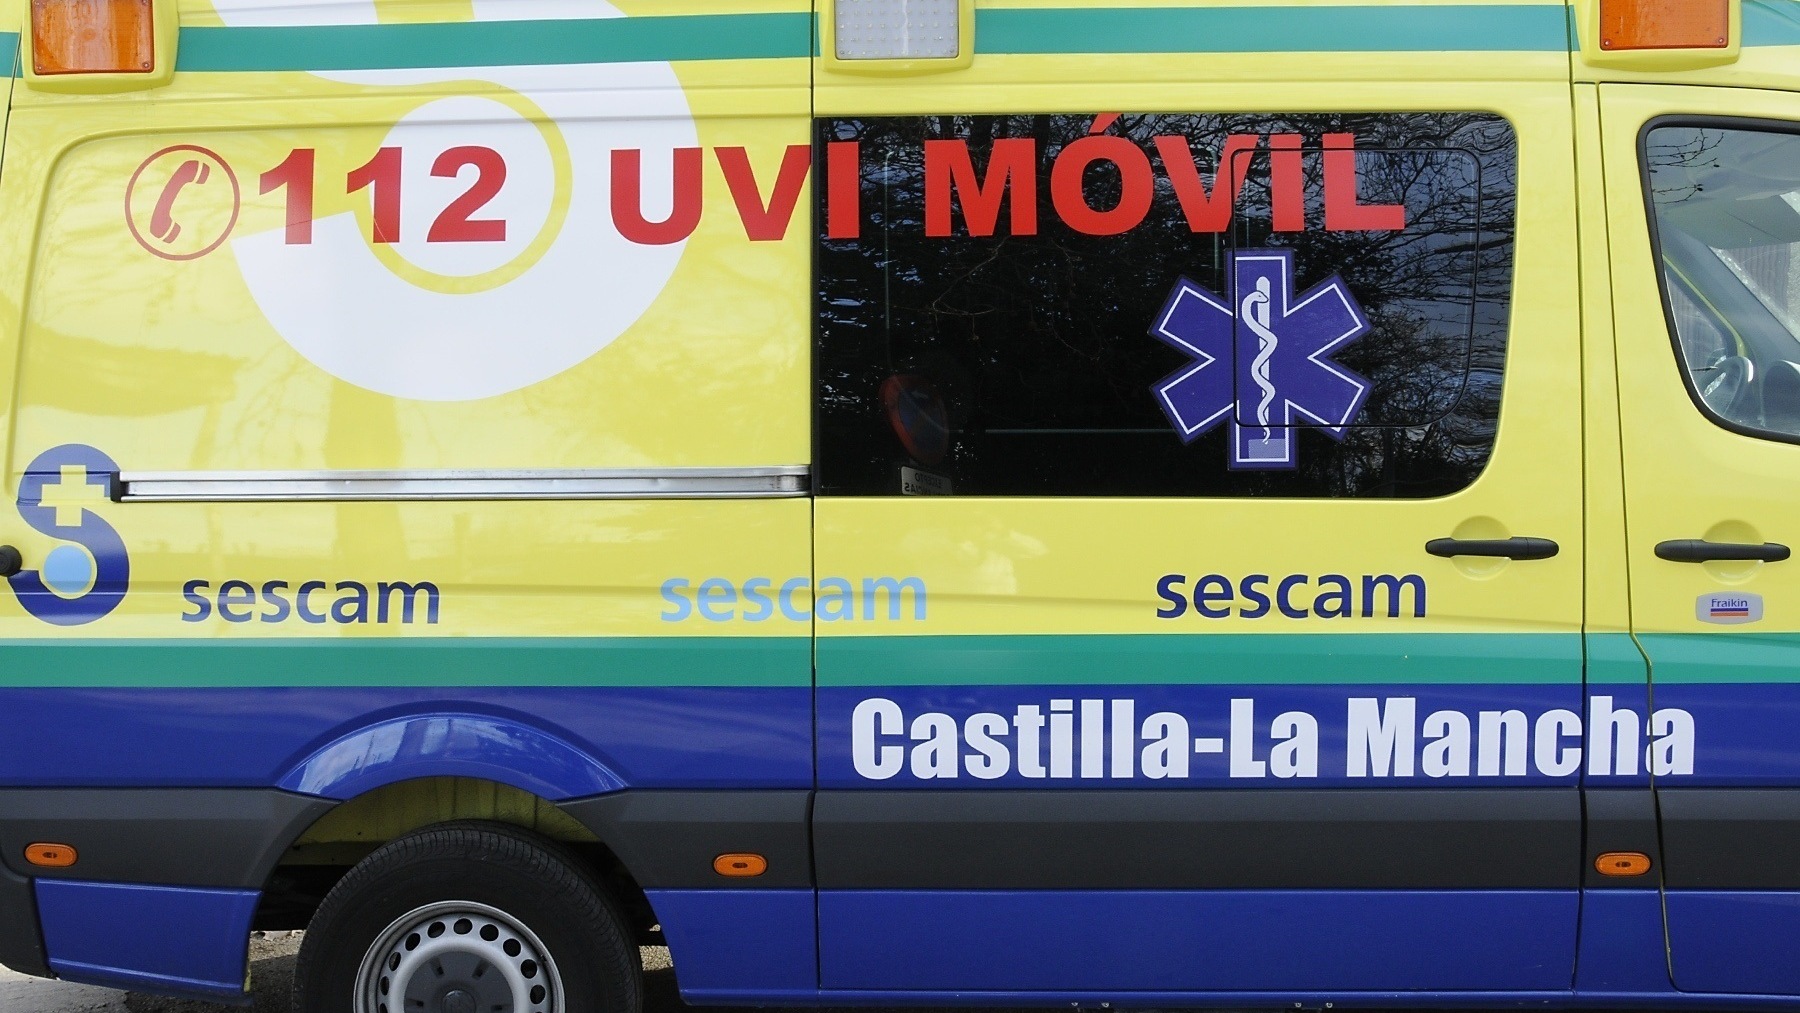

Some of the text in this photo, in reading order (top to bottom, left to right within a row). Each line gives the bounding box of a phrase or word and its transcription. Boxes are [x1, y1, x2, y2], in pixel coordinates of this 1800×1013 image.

[259, 113, 1405, 245] 112 UVI MÓVIL
[182, 577, 440, 624] sescam
[660, 576, 927, 622] sescam
[1157, 573, 1427, 619] sescam
[1711, 598, 1748, 608] Fraikin
[852, 695, 1695, 780] Castilla-La Mancha
